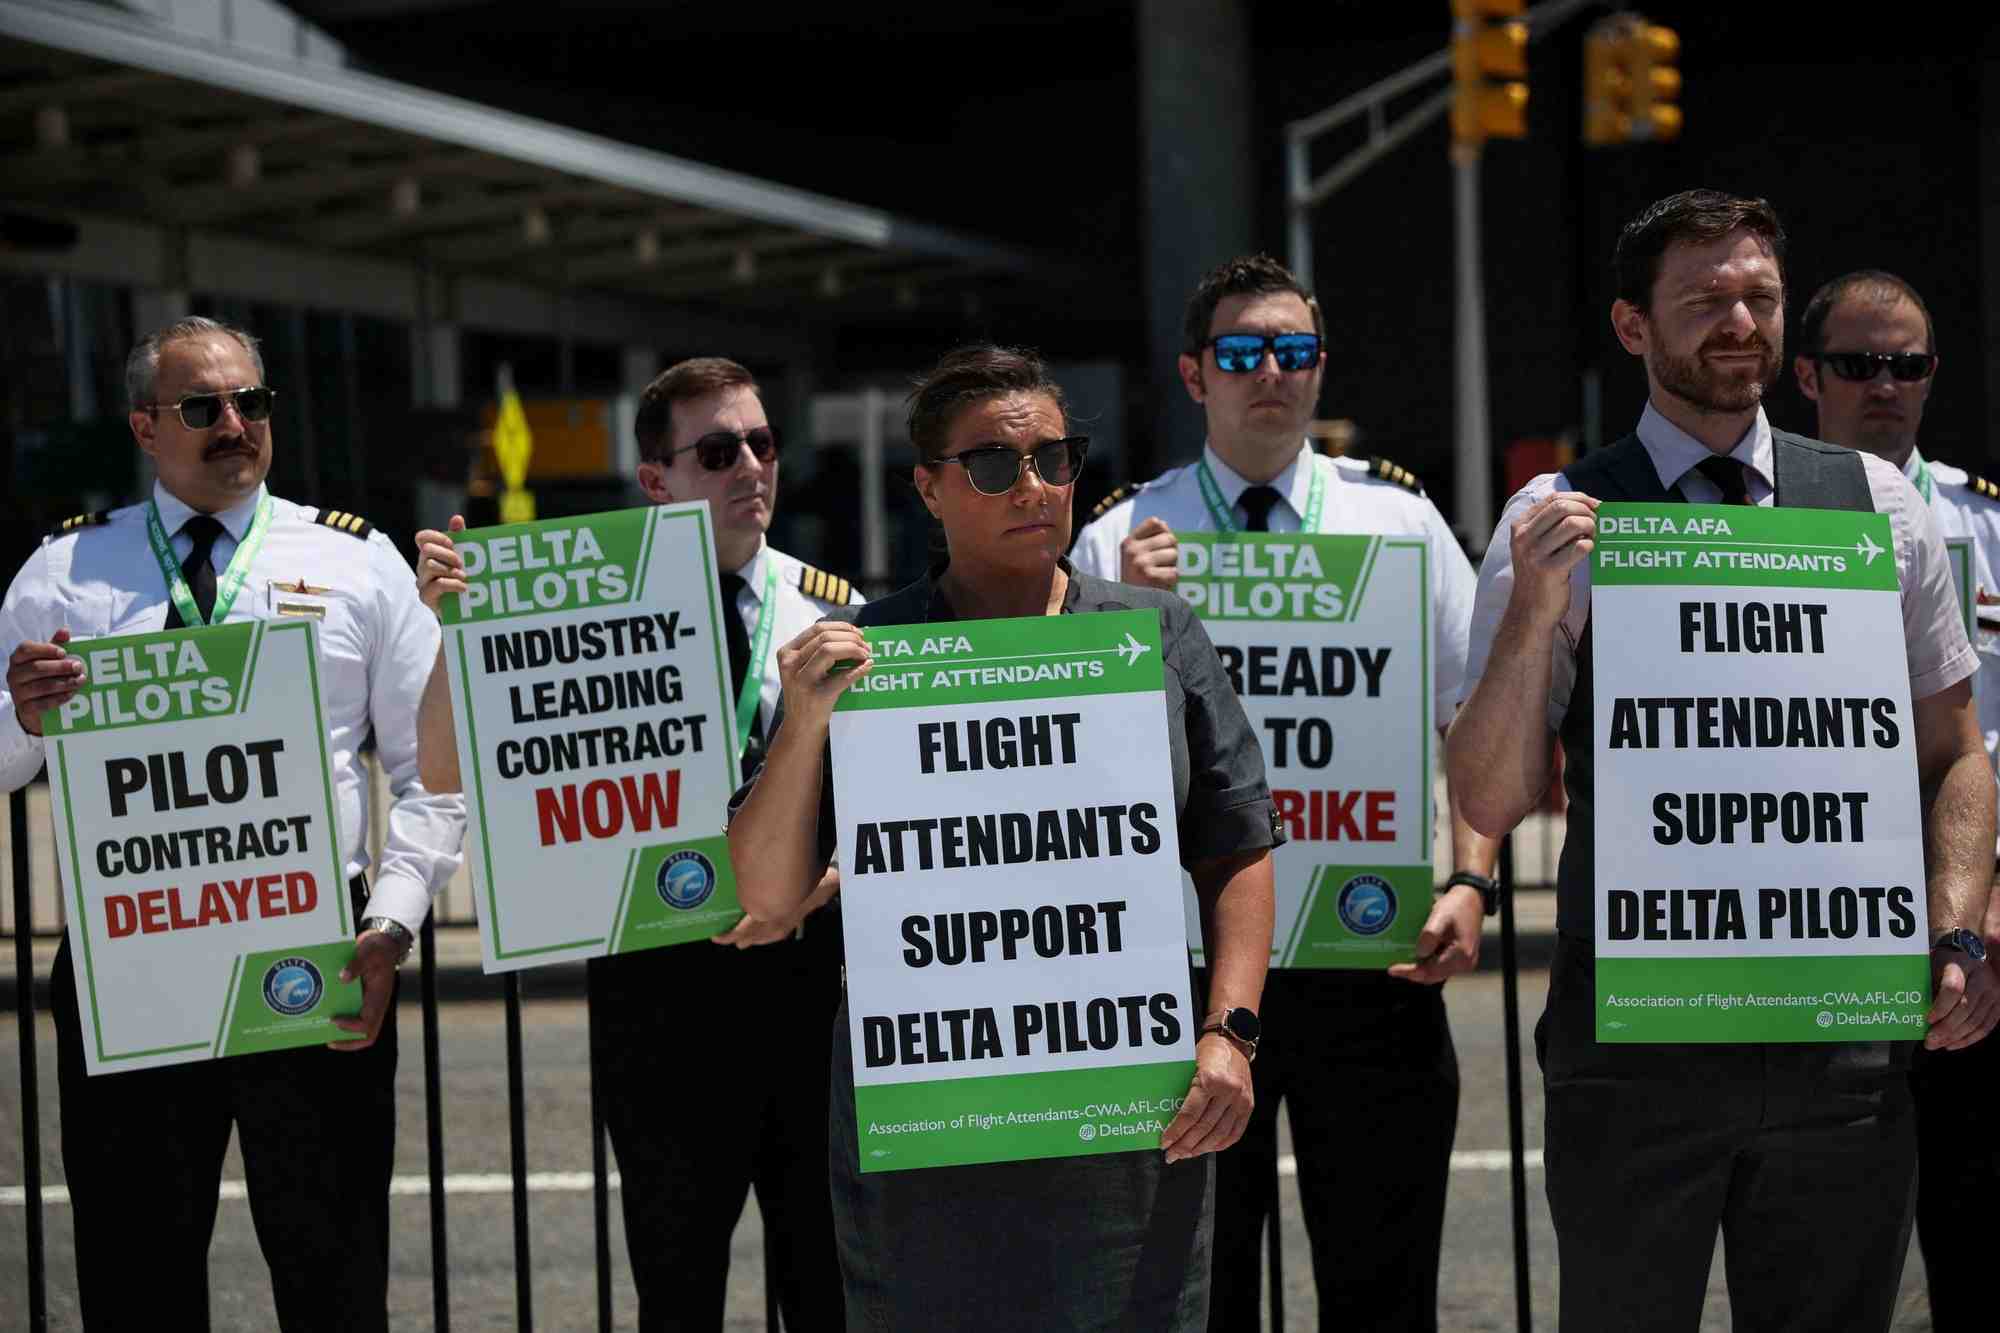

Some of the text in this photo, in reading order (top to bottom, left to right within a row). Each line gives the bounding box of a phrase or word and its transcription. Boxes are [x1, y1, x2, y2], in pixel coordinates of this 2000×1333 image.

[454, 526, 605, 576] DELTA
[1600, 517, 1732, 535] DELTA AFA
[1177, 543, 1324, 578] DELTA
[1600, 551, 1847, 572] FLIGHT ATTENDANTS
[459, 564, 628, 618] PILOTS
[1177, 582, 1344, 618] PILOTS
[481, 611, 695, 673] INDUSTRY-
[865, 636, 973, 657] LTA AFA
[1679, 602, 1827, 653] FLIGHT
[59, 676, 232, 729] PILOTS
[510, 665, 683, 724] LEADING
[849, 660, 1104, 692] LIGHT ATTENDANTS
[497, 714, 707, 779] CONTRACT
[918, 713, 1080, 773] FLIGHT
[1263, 717, 1334, 769] TO
[1608, 698, 1900, 748] ATTENDANTS
[105, 739, 284, 817] PILOT
[535, 769, 681, 846] NOW
[1270, 789, 1396, 841] RIKE
[1652, 792, 1868, 845] SUPPORT
[96, 815, 311, 877] CONTRACT
[854, 803, 1160, 874] ATTENDANTS
[104, 871, 317, 938] DELAYED
[1607, 887, 1916, 940] DELTA PILOTS
[901, 901, 1126, 968] SUPPORT
[1606, 994, 1684, 1007] Association
[1689, 994, 1703, 1007] of
[1707, 993, 1743, 1010] Flight
[862, 993, 1180, 1068] DELTA PILOTS
[868, 1119, 945, 1135] Association
[950, 1115, 966, 1129] of
[968, 1113, 1006, 1130] Flight
